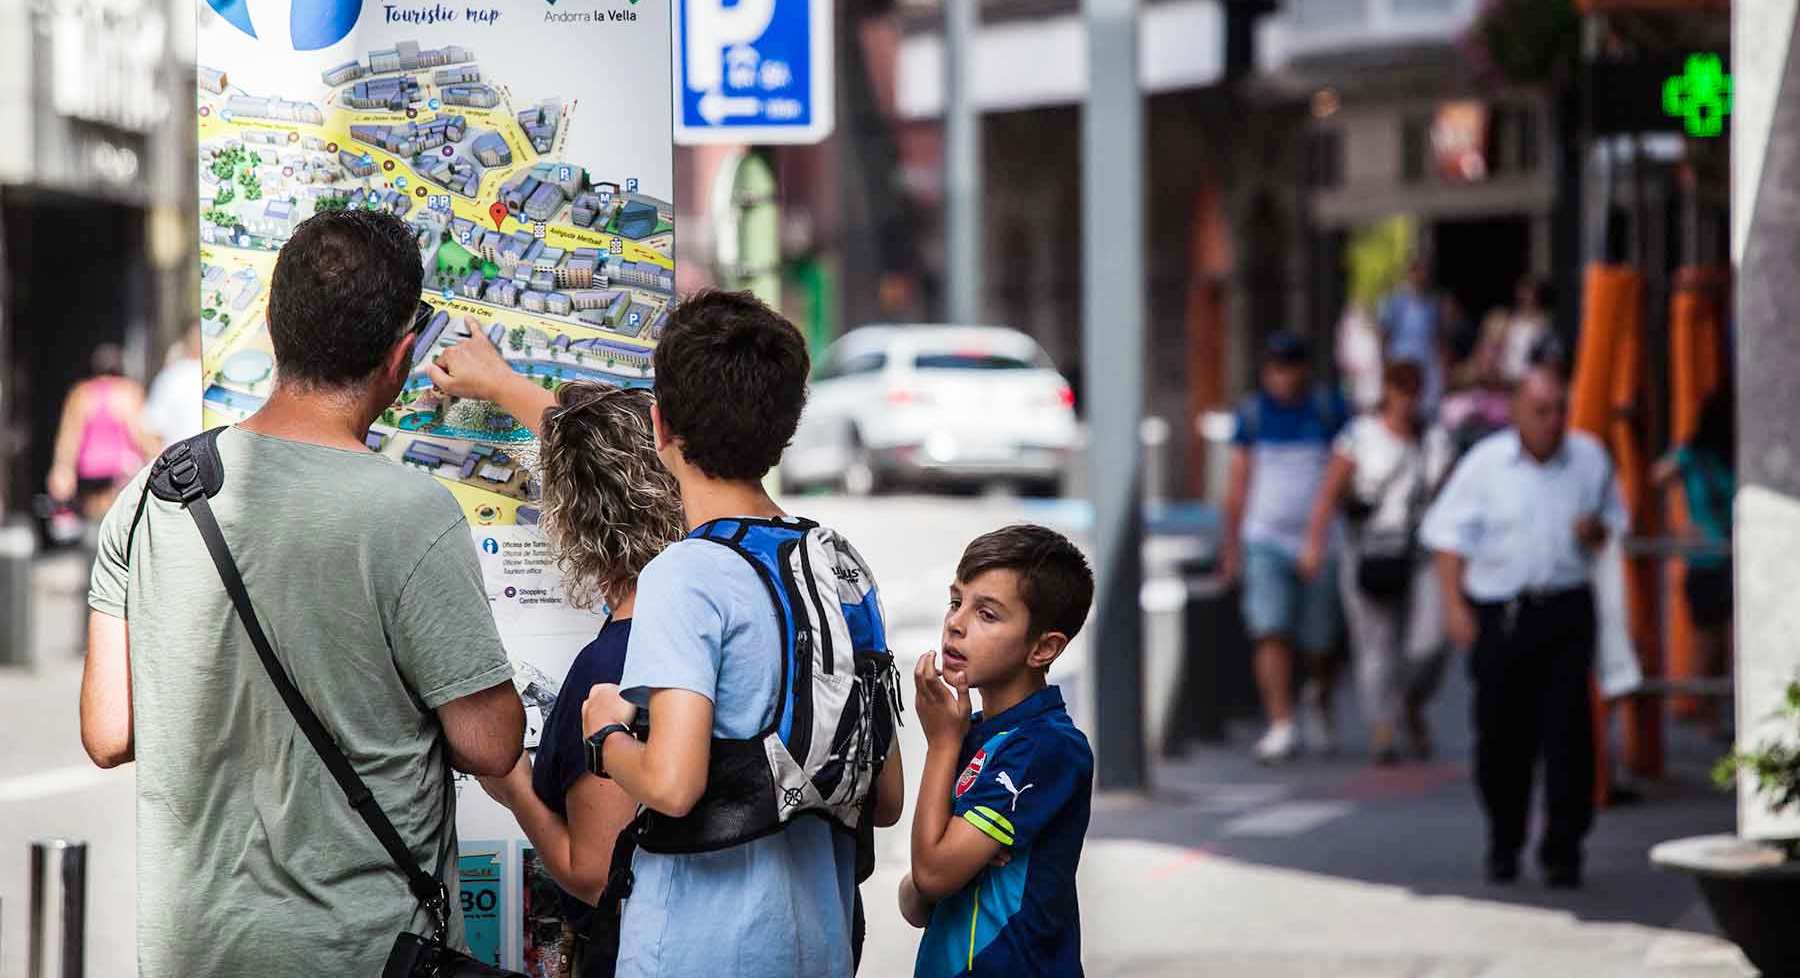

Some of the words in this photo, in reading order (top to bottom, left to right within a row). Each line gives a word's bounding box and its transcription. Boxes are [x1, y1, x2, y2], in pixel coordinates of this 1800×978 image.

[384, 4, 457, 24] Touristic
[466, 8, 502, 26] map
[544, 10, 590, 23] Andorra
[594, 10, 605, 22] la
[608, 10, 637, 22] Vella
[519, 588, 547, 596] Shopping
